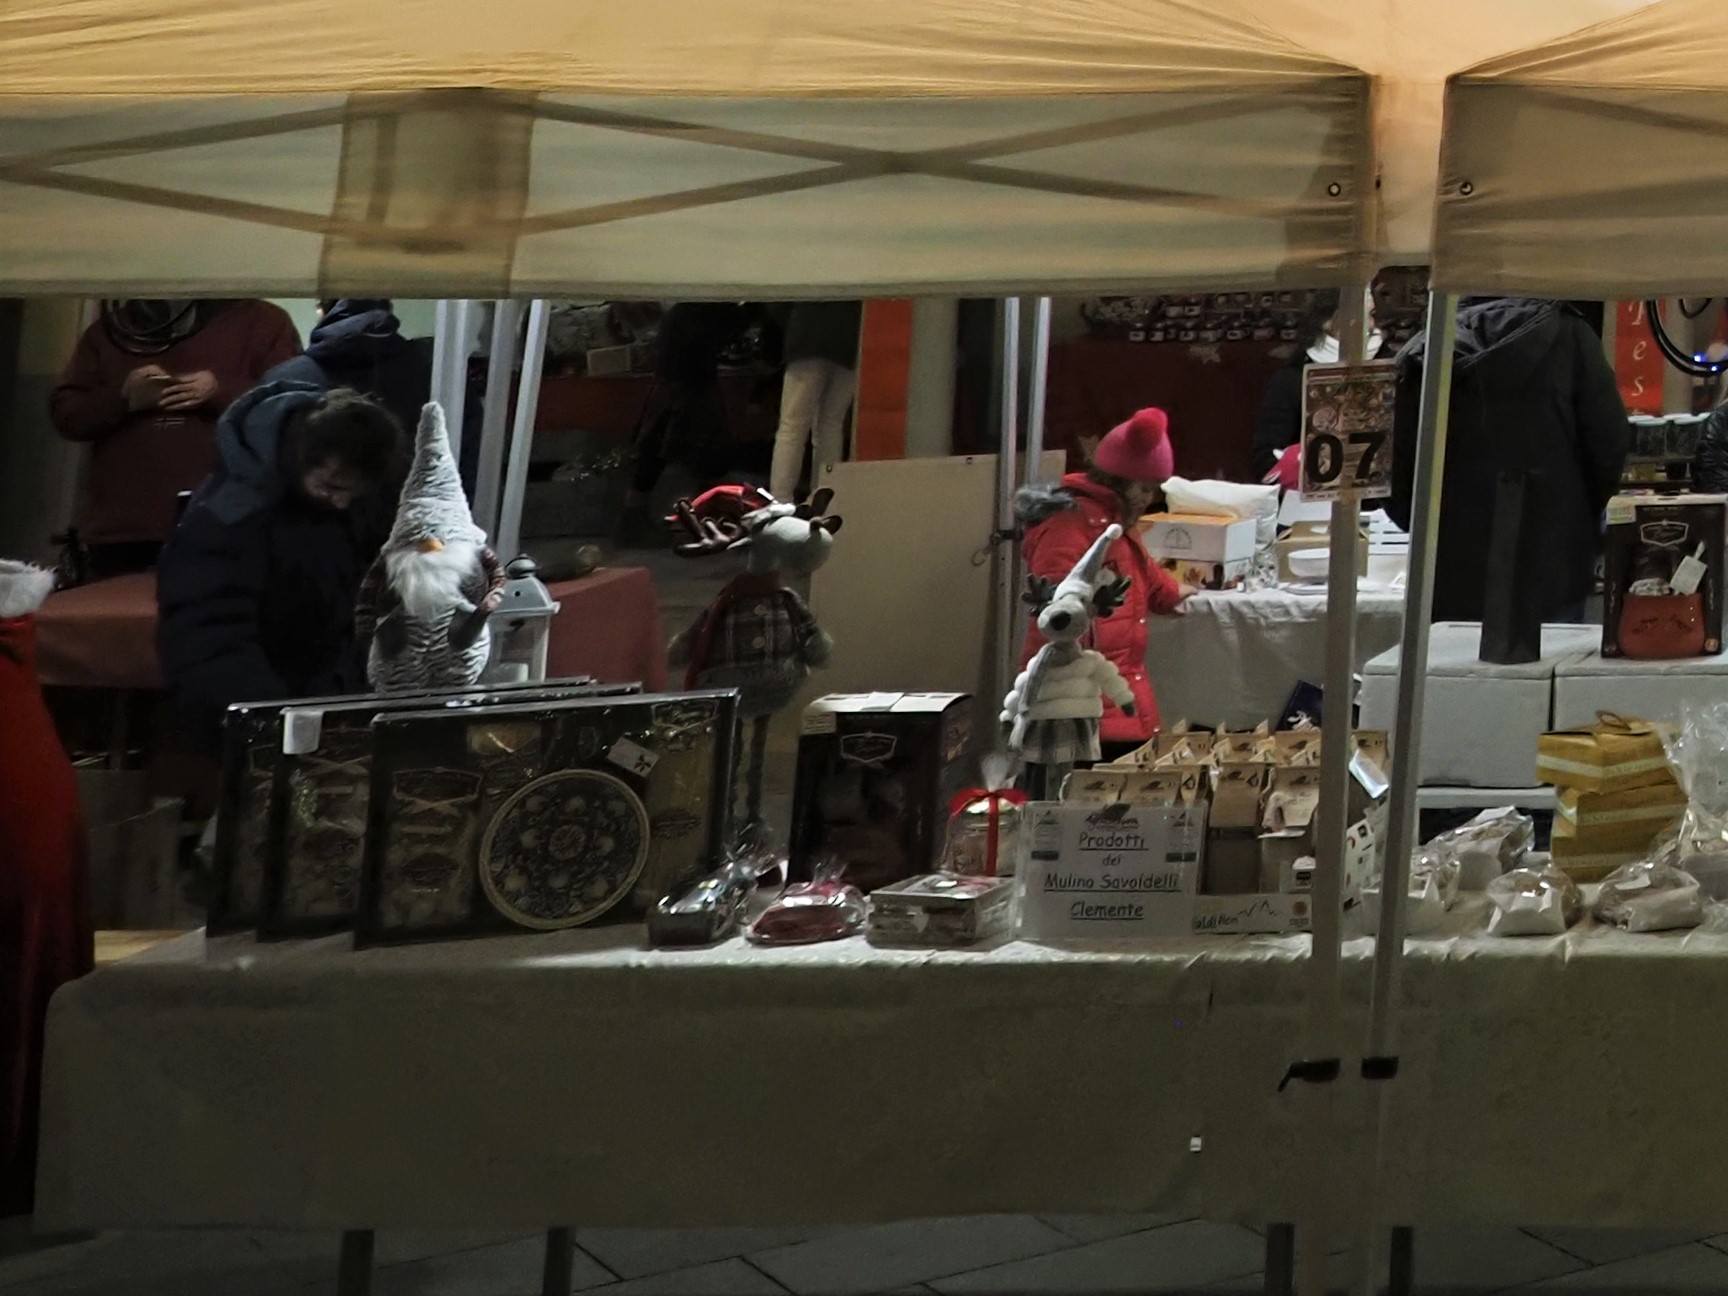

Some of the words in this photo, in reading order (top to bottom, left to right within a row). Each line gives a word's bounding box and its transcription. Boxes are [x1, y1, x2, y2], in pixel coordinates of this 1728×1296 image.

[1307, 431, 1386, 483] 07
[1079, 832, 1145, 848] Prodotti
[1045, 874, 1095, 889] Mulino
[1100, 873, 1179, 889] Savoldelli
[1070, 901, 1145, 919] Clemente
